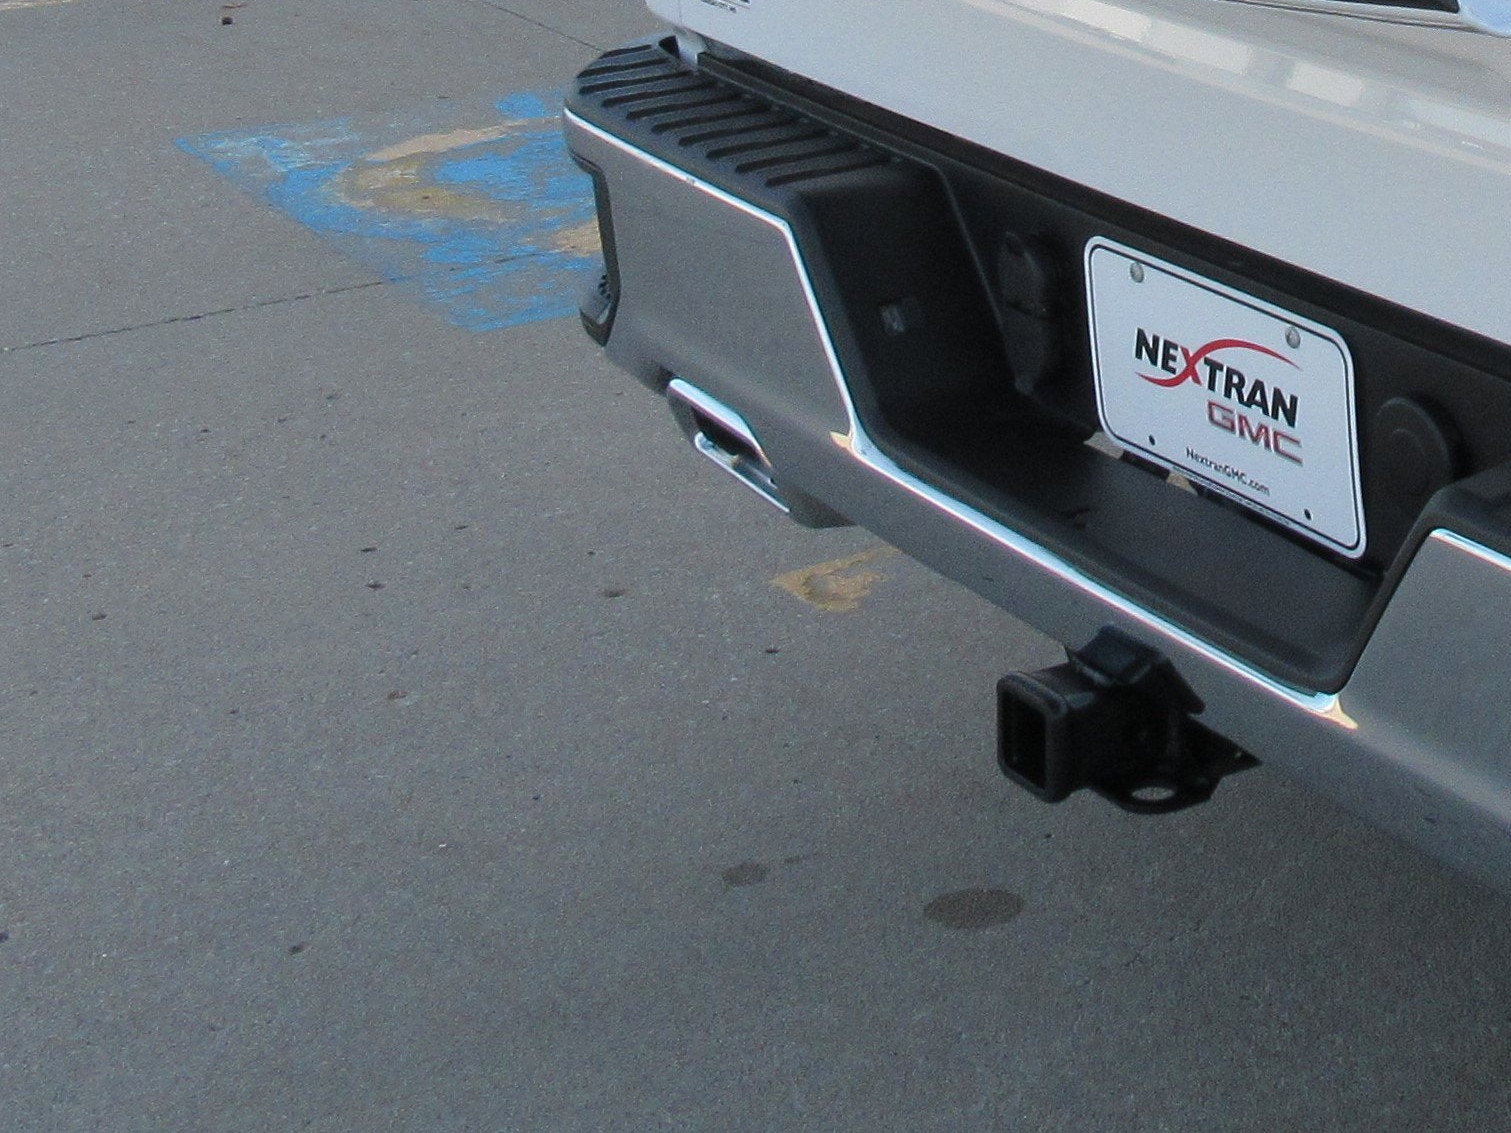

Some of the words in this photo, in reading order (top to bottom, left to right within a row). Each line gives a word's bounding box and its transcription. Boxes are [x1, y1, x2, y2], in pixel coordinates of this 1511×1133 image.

[1134, 327, 1300, 428] NEXTRAN
[1207, 399, 1302, 467] GMC
[1186, 446, 1270, 497] NextranGMC.com
